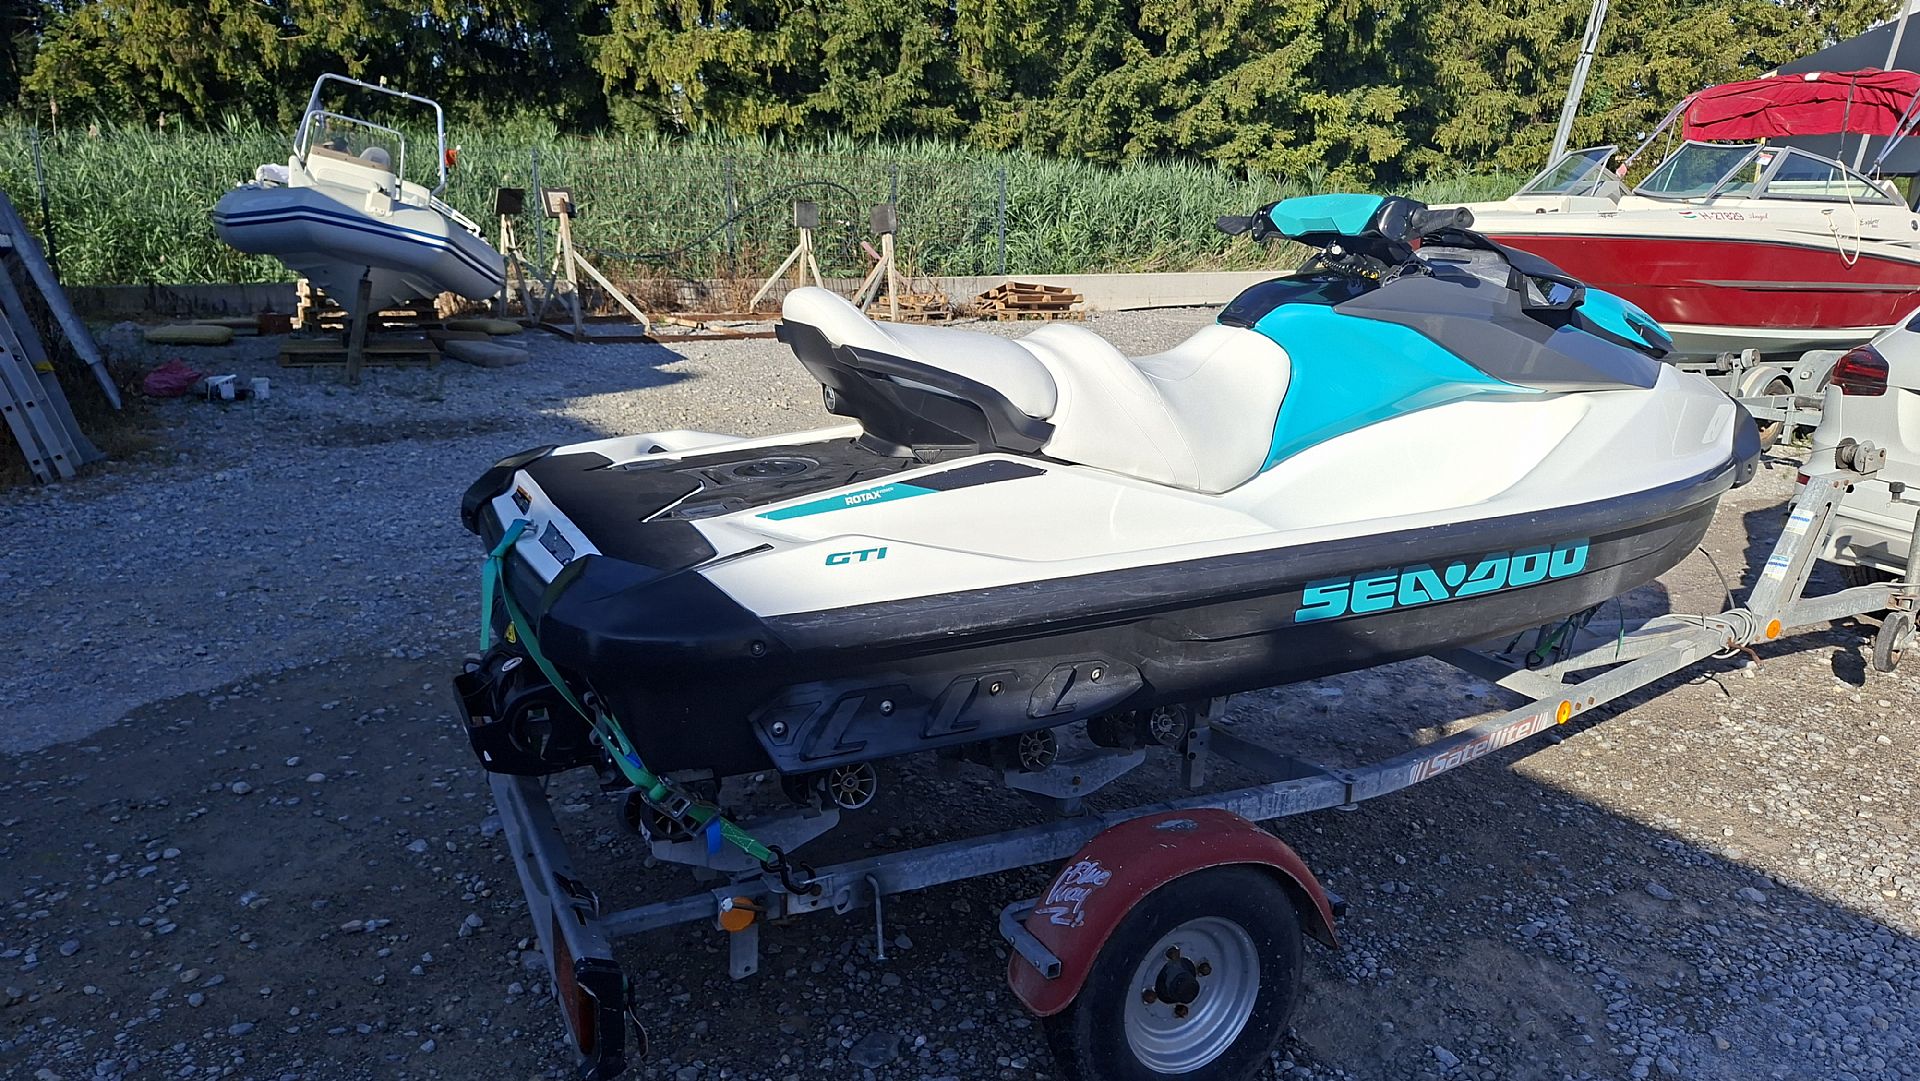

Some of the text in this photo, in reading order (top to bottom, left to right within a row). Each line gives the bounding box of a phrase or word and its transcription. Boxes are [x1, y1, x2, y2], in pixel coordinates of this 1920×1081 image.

[845, 491, 881, 505] ROTAX
[825, 547, 888, 566] GTI
[1427, 720, 1533, 775] Satellite
